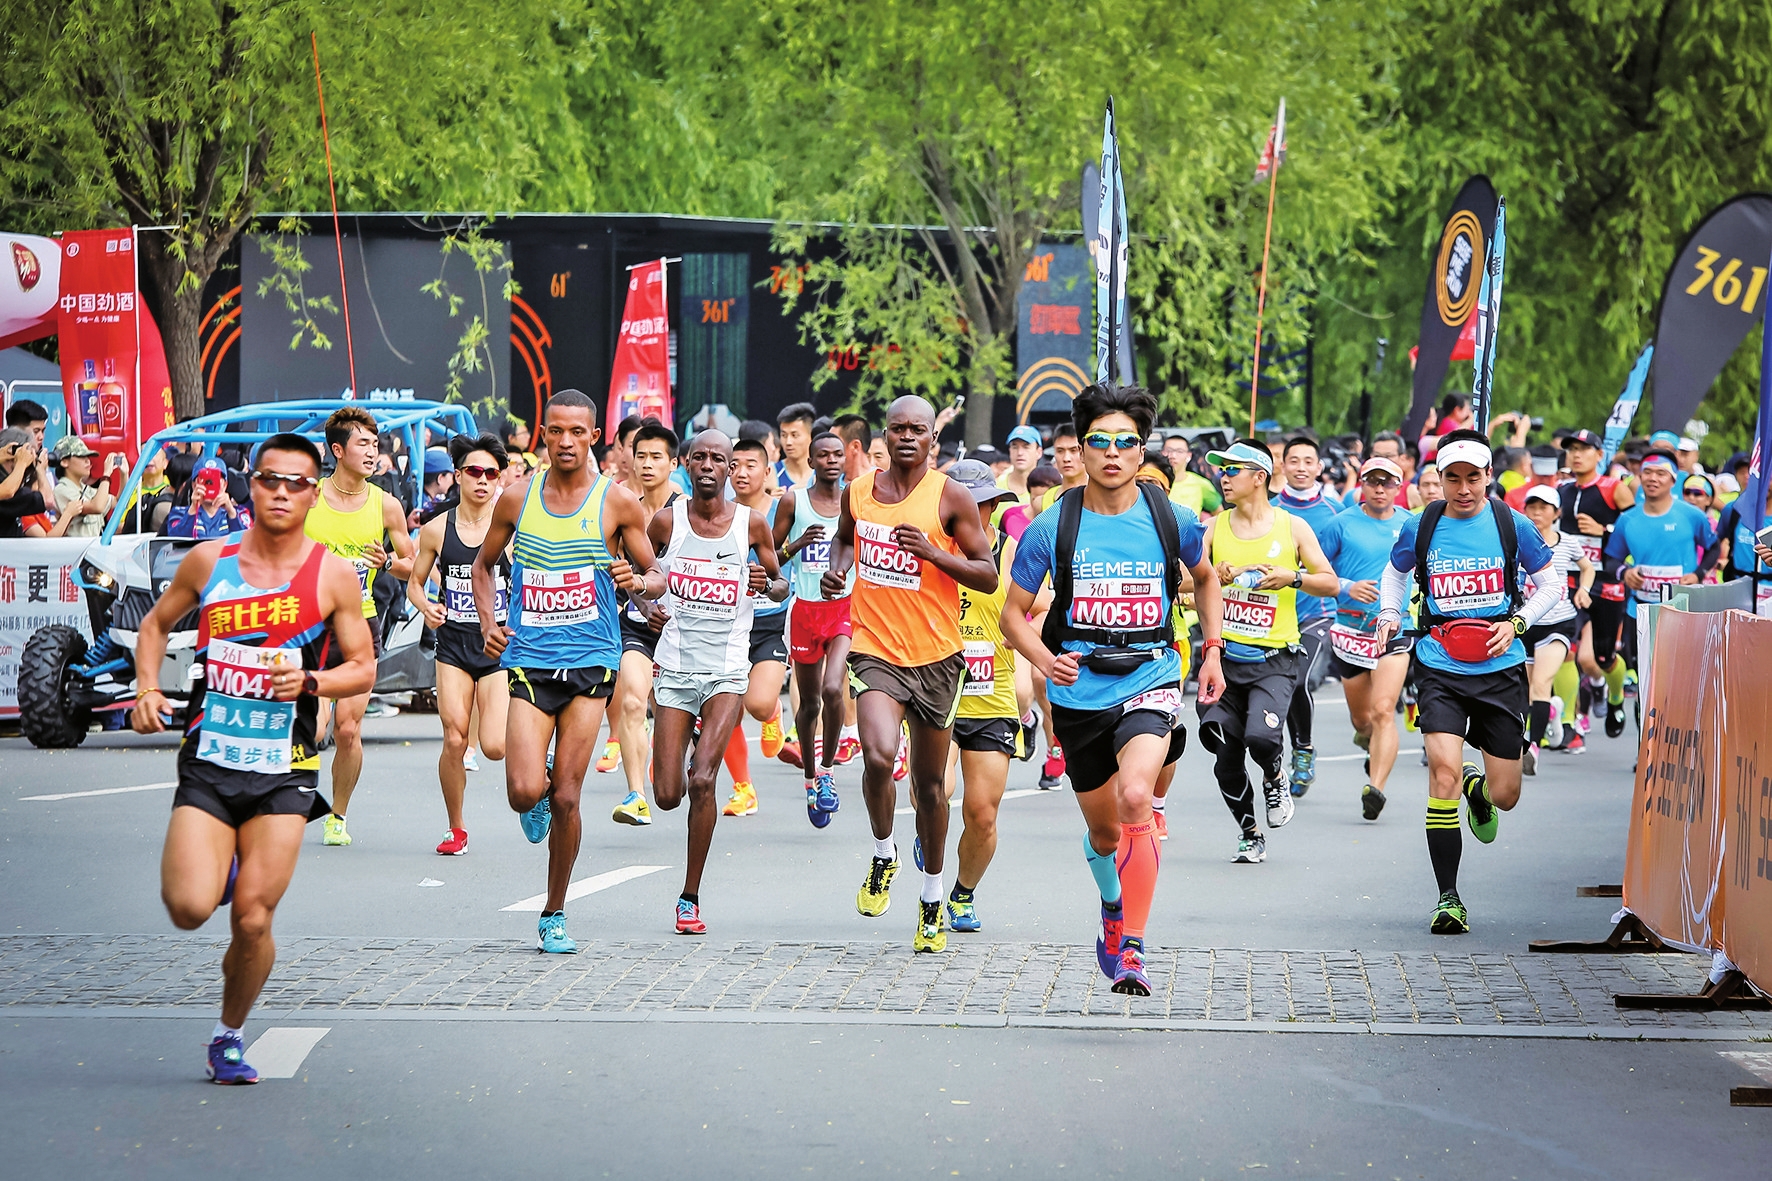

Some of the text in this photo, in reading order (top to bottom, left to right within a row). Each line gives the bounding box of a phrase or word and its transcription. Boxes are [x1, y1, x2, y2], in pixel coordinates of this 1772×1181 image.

[60, 292, 134, 313] 中国劲酒
[702, 298, 736, 323] 361°
[860, 540, 919, 574] M0505
[1073, 547, 1090, 563] 61°
[1454, 557, 1477, 571] ME
[531, 573, 549, 587] 361°
[682, 562, 702, 576] 361°
[1106, 562, 1133, 576] ME
[670, 575, 737, 604] M0296
[1089, 582, 1114, 597] 361°
[1434, 572, 1499, 598] M0511
[525, 586, 593, 612] M0965
[208, 595, 300, 638] 康比特
[1077, 600, 1159, 626] M0519
[1223, 601, 1273, 626] M0495
[222, 646, 248, 664] 361°
[206, 663, 276, 699] M047
[210, 704, 288, 730] 懒人管家
[224, 745, 283, 765] 跑步袜
